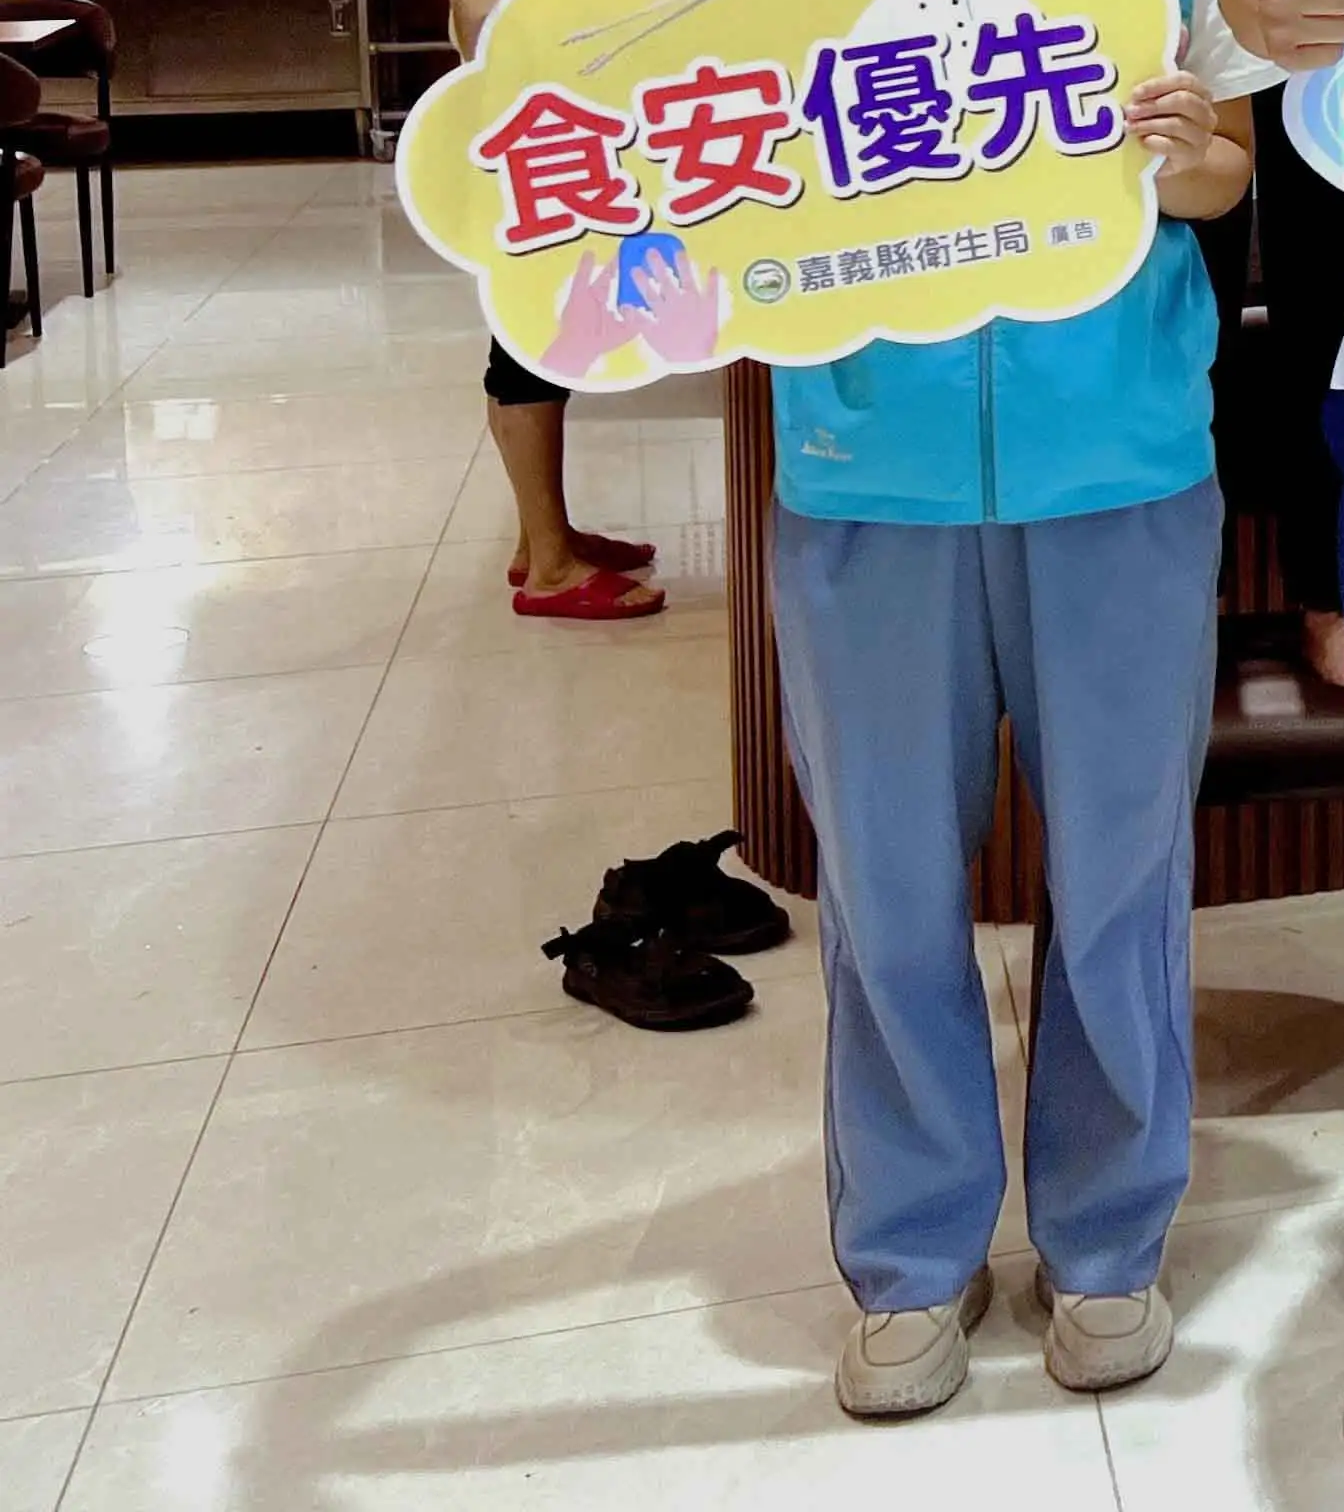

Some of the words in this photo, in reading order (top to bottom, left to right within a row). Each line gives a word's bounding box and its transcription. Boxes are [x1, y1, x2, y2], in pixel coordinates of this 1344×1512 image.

[479, 12, 1115, 244] 食安優先
[797, 221, 1028, 291] 嘉義縣衛生局
[1050, 220, 1094, 246] 廣告
